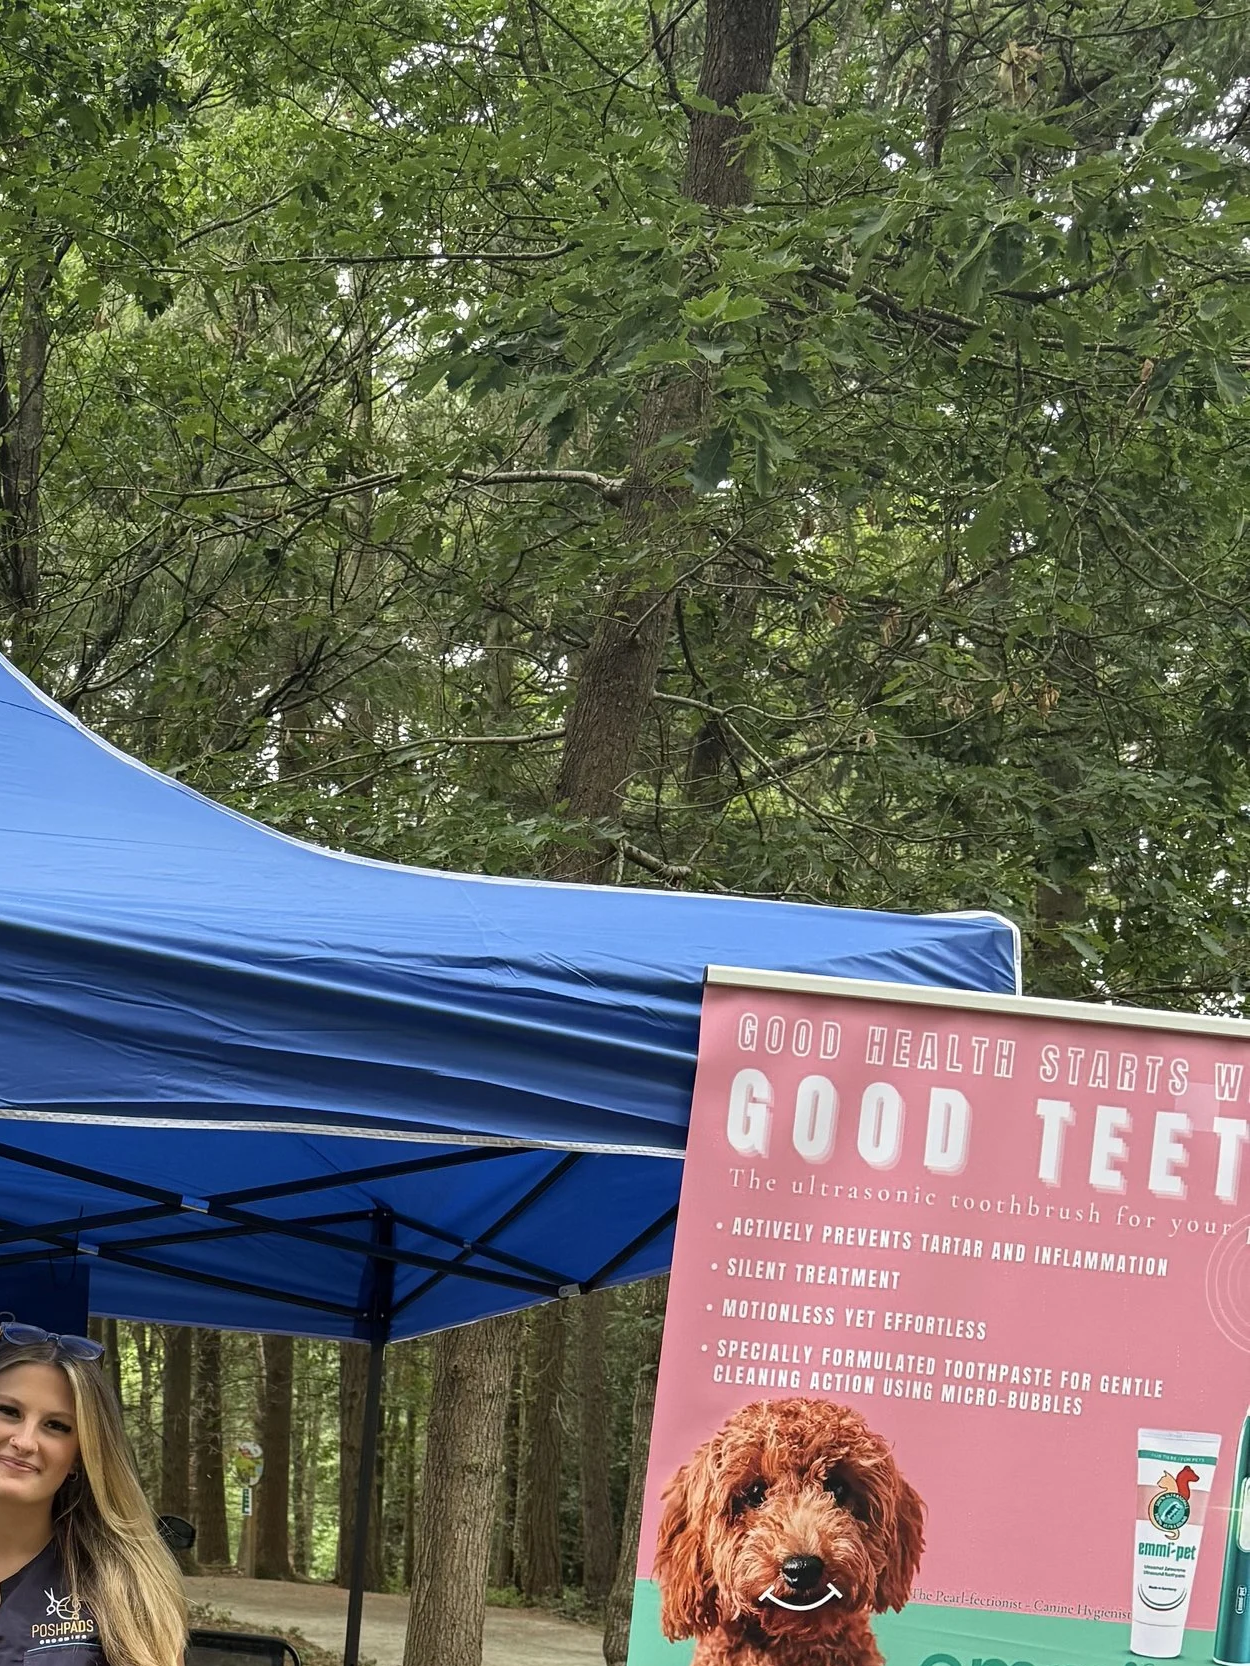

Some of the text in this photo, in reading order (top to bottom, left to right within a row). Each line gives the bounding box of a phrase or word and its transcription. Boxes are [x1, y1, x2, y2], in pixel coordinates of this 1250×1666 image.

[737, 1012, 842, 1060] GOOD
[865, 1025, 1016, 1079] HEALTH
[1039, 1044, 1190, 1097] STARTS
[726, 1067, 1249, 1203] GOOD TEET
[729, 1168, 776, 1191] The
[792, 1174, 936, 1206] ultrasonic
[951, 1193, 1100, 1224] toothbrush
[1116, 1205, 1156, 1228] for
[1168, 1219, 1232, 1238] your
[727, 1257, 901, 1290] SILENT TREATMENT
[732, 1217, 1168, 1277] ACTIVELY PREVENTS TARTAR AND INFLAMMATION
[722, 1298, 987, 1340] MOTIONLESS YET EFFORTLESS
[713, 1364, 1083, 1416] CLEANING ACTION USING MICRO-BUBBLES
[717, 1339, 1163, 1398] SPECIALLY FORMULATED TOOTHPASTE FOR GENTLE
[31, 1620, 94, 1638] POSHPADS
